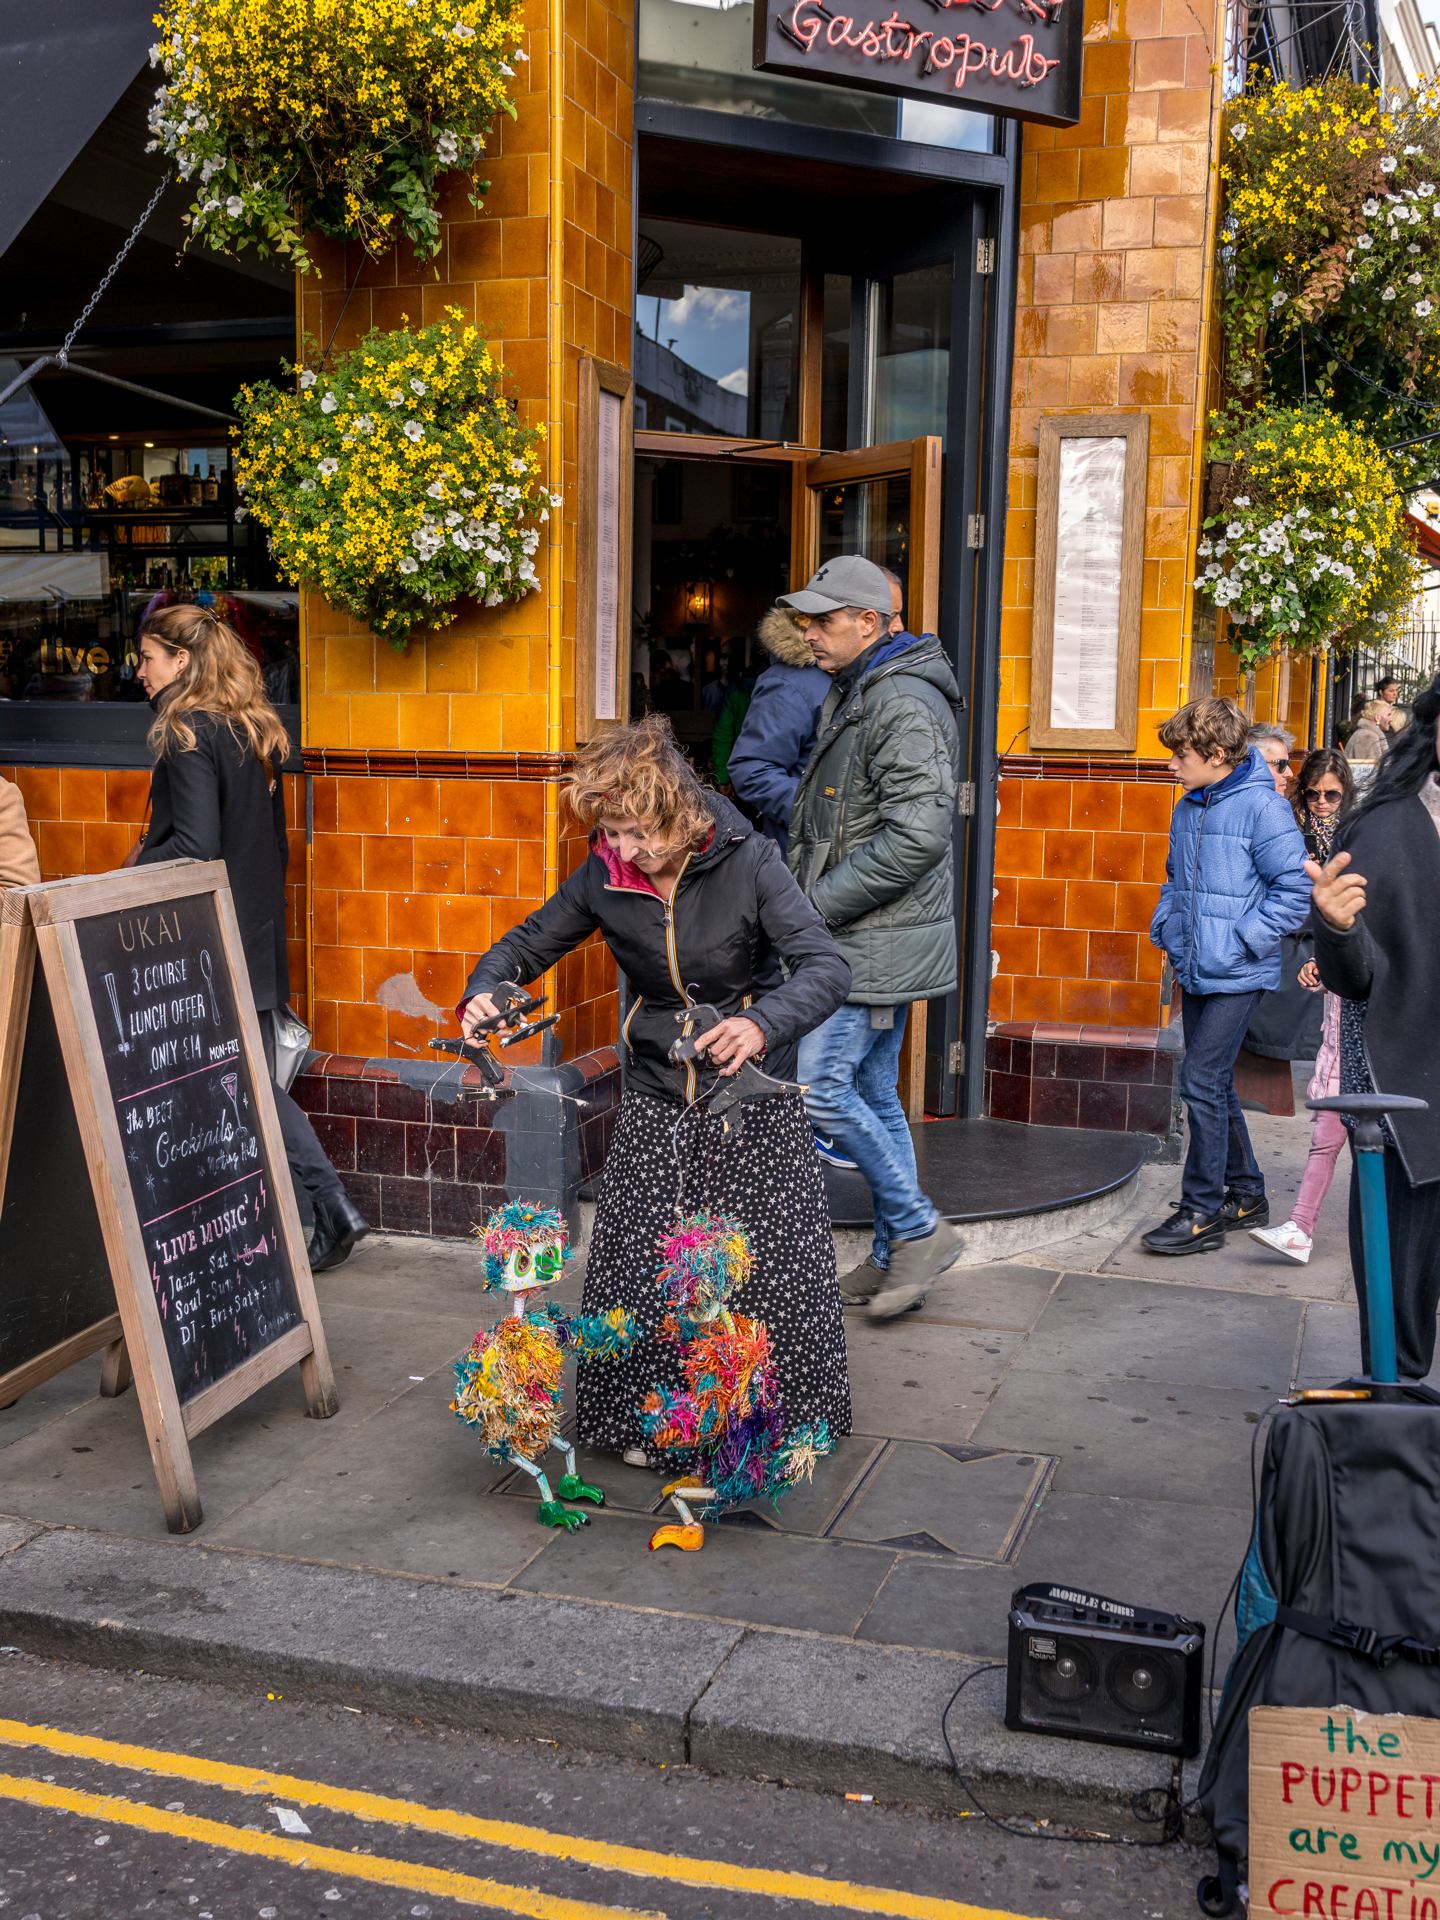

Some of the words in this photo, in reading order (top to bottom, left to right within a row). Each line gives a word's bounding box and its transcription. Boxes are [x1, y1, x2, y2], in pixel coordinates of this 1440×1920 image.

[791, 0, 1060, 88] Gastropub
[40, 637, 110, 674] Live
[118, 911, 182, 951] UKAI
[131, 968, 141, 996] 3
[144, 958, 188, 992] COURSE
[129, 1000, 168, 1036] LUNCH
[171, 993, 206, 1025] OFFER
[151, 1039, 178, 1072] ONLY
[209, 1039, 240, 1061] MON-FRI
[147, 1100, 174, 1127] BEST
[156, 1108, 234, 1168] Cocktails
[241, 1136, 258, 1162] Hill
[168, 1271, 196, 1300] Jazz
[209, 1250, 229, 1275] Sat
[175, 1288, 202, 1321] Soul
[209, 1304, 227, 1329] Fri
[1049, 1587, 1099, 1609] MOBILE
[1101, 1600, 1136, 1618] CUBE
[1028, 1650, 1057, 1662] Roland
[1281, 1761, 1440, 1819] PUPPET
[1288, 1826, 1361, 1860] are
[1383, 1840, 1440, 1879] my
